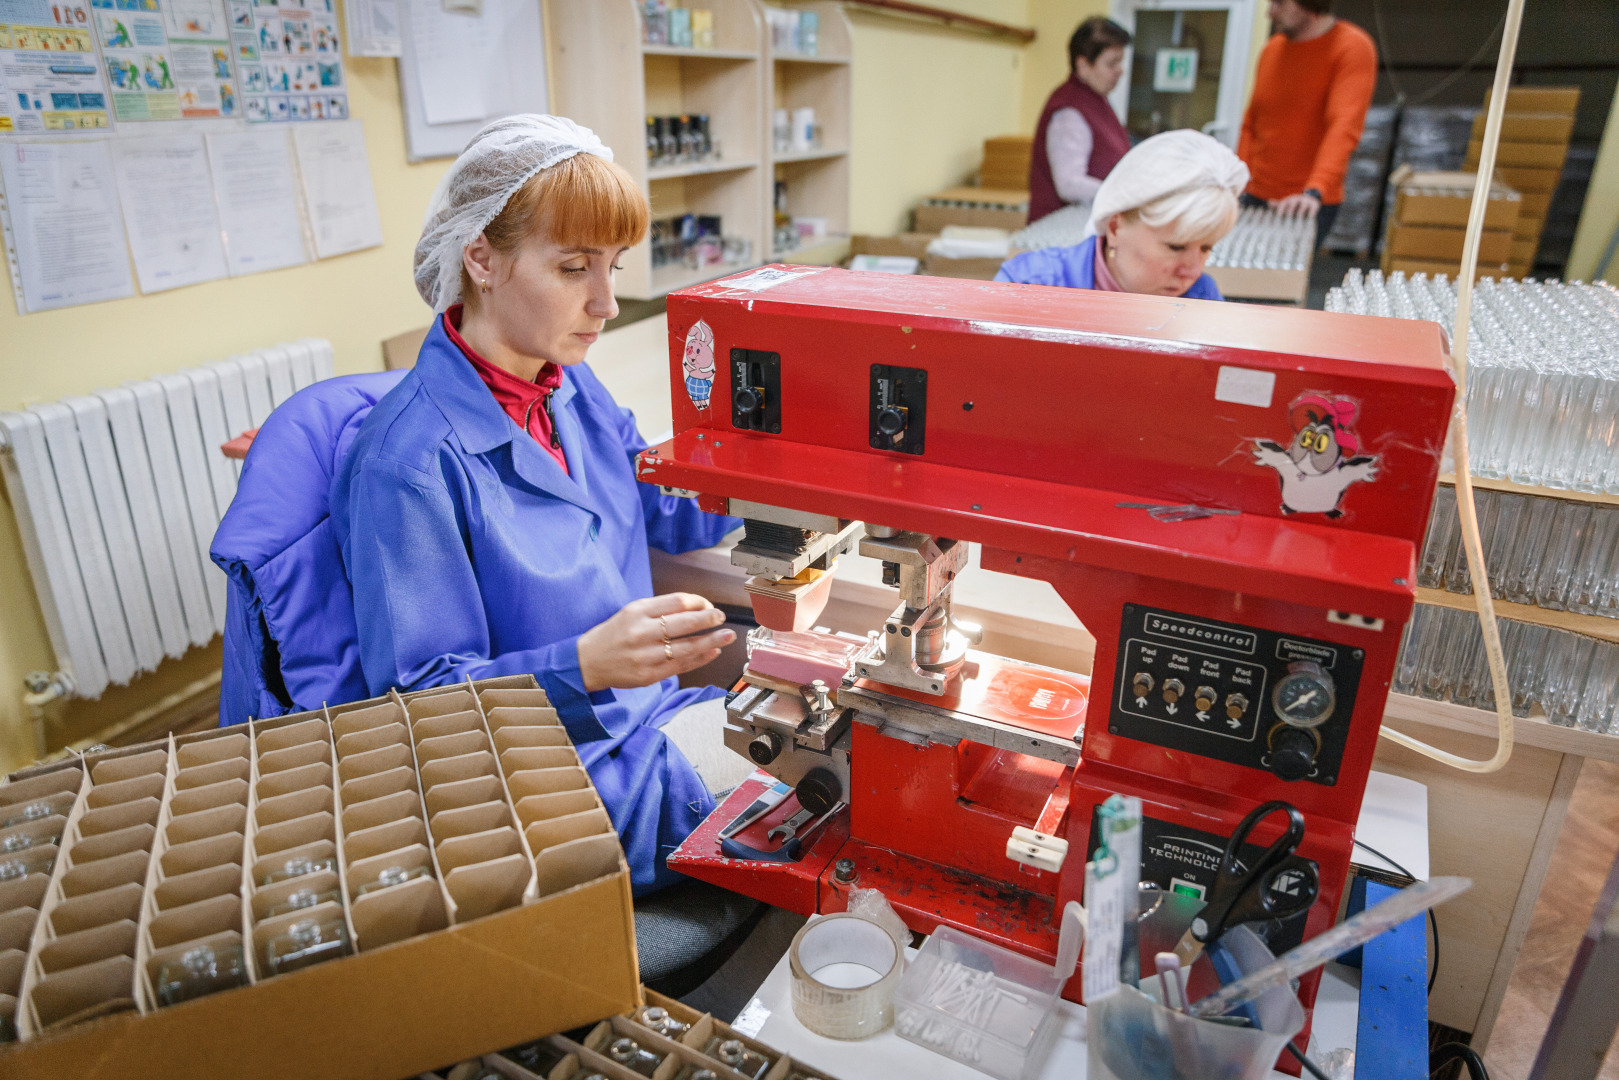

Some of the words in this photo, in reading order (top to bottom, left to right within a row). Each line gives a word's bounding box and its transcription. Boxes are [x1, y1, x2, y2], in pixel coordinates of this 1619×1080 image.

[1152, 619, 1251, 647] Speedcontrol
[1140, 646, 1157, 656] Pad
[1142, 656, 1154, 664] up
[1171, 653, 1189, 663] Pad
[1167, 661, 1190, 672] down
[1203, 660, 1220, 670] Pad
[1199, 668, 1220, 678] front
[1235, 667, 1252, 677] Pad
[1232, 675, 1252, 685] back
[1183, 872, 1196, 881] ON
